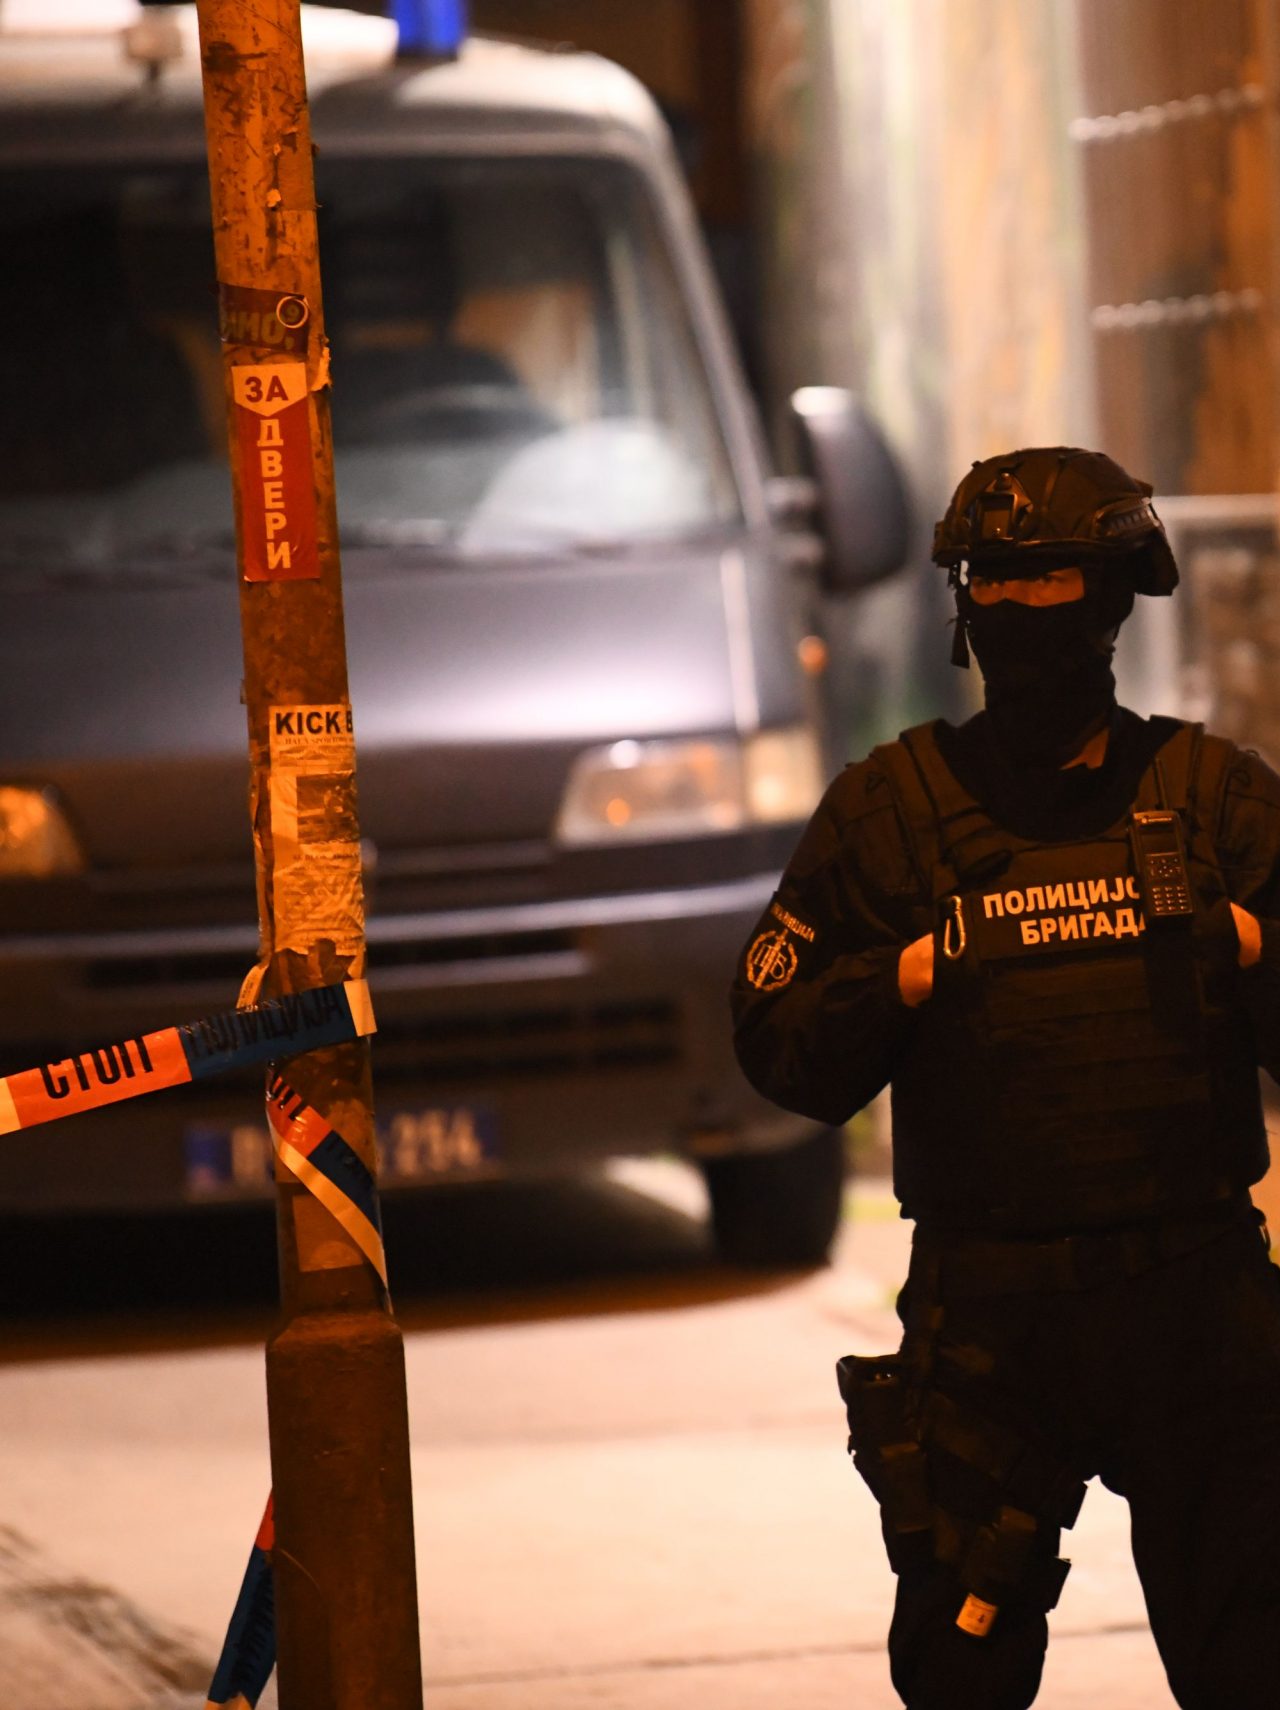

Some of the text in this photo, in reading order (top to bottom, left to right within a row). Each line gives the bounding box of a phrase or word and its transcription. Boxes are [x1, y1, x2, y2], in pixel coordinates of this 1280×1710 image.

[244, 375, 289, 403] ЗА
[256, 418, 293, 570] ДВЕРИ
[983, 876, 1140, 919] ПОЛИЦИЈС
[1020, 907, 1147, 945] БРИГАД
